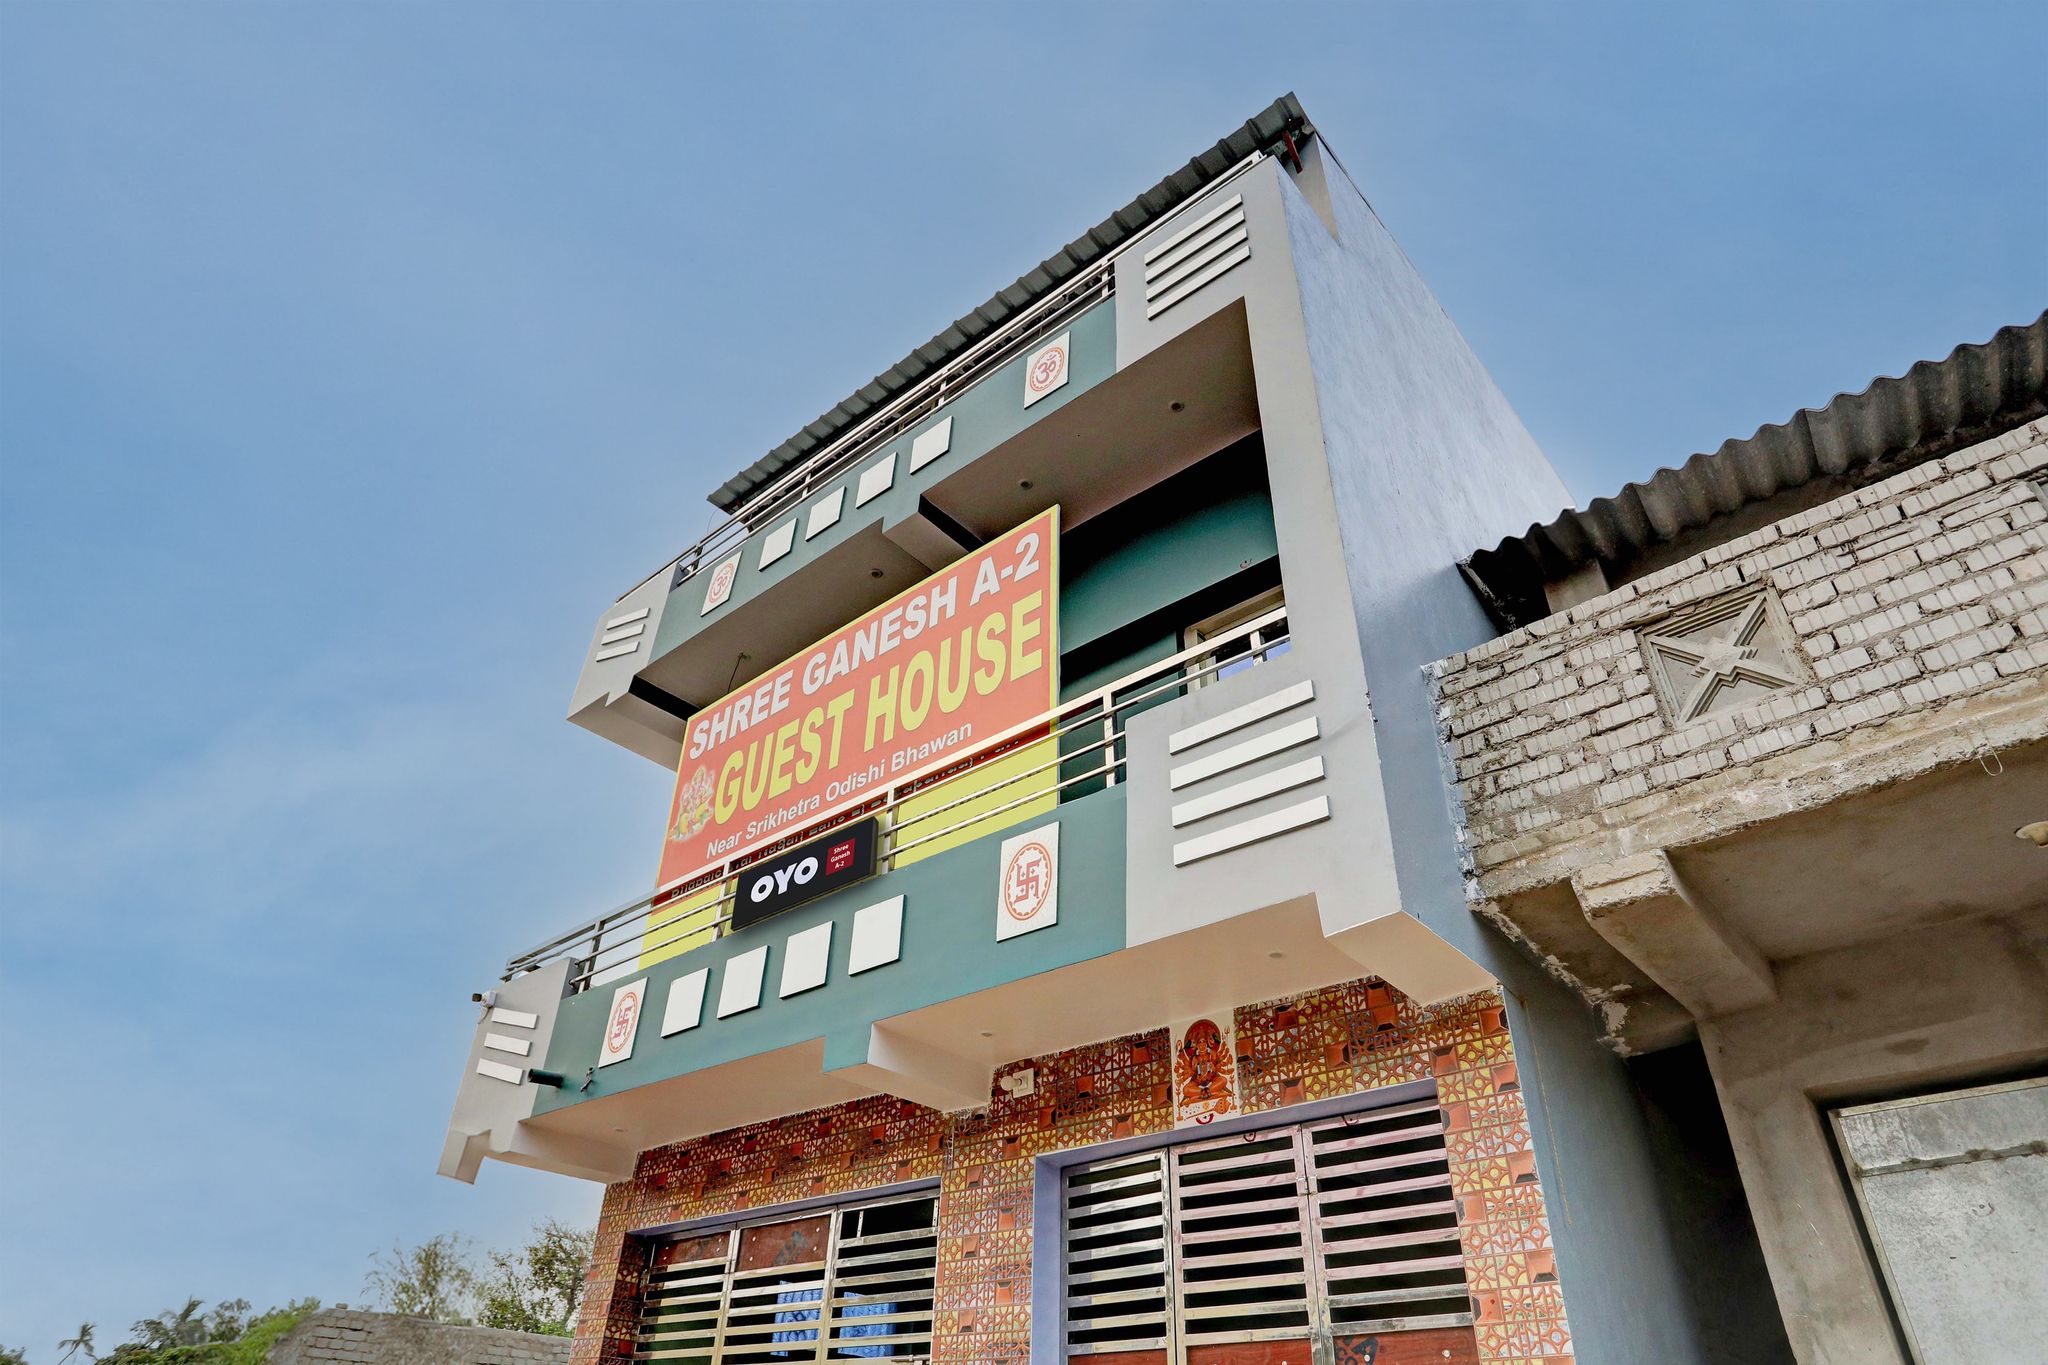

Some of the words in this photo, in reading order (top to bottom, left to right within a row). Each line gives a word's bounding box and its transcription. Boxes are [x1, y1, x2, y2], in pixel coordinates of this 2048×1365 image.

[689, 669, 796, 760] SHREE
[801, 575, 958, 696] GANESH
[969, 532, 1040, 604] A-2
[714, 688, 857, 826] GUEST
[863, 589, 1043, 752] HOUSE
[706, 833, 743, 860] Near
[745, 795, 820, 842] Srikhetra
[826, 759, 886, 803] Odishi
[890, 722, 973, 773] Bhawan
[830, 850, 851, 863] Ganesh
[833, 844, 849, 855] Shree
[834, 860, 845, 869] A-2
[750, 856, 819, 904] OYO
